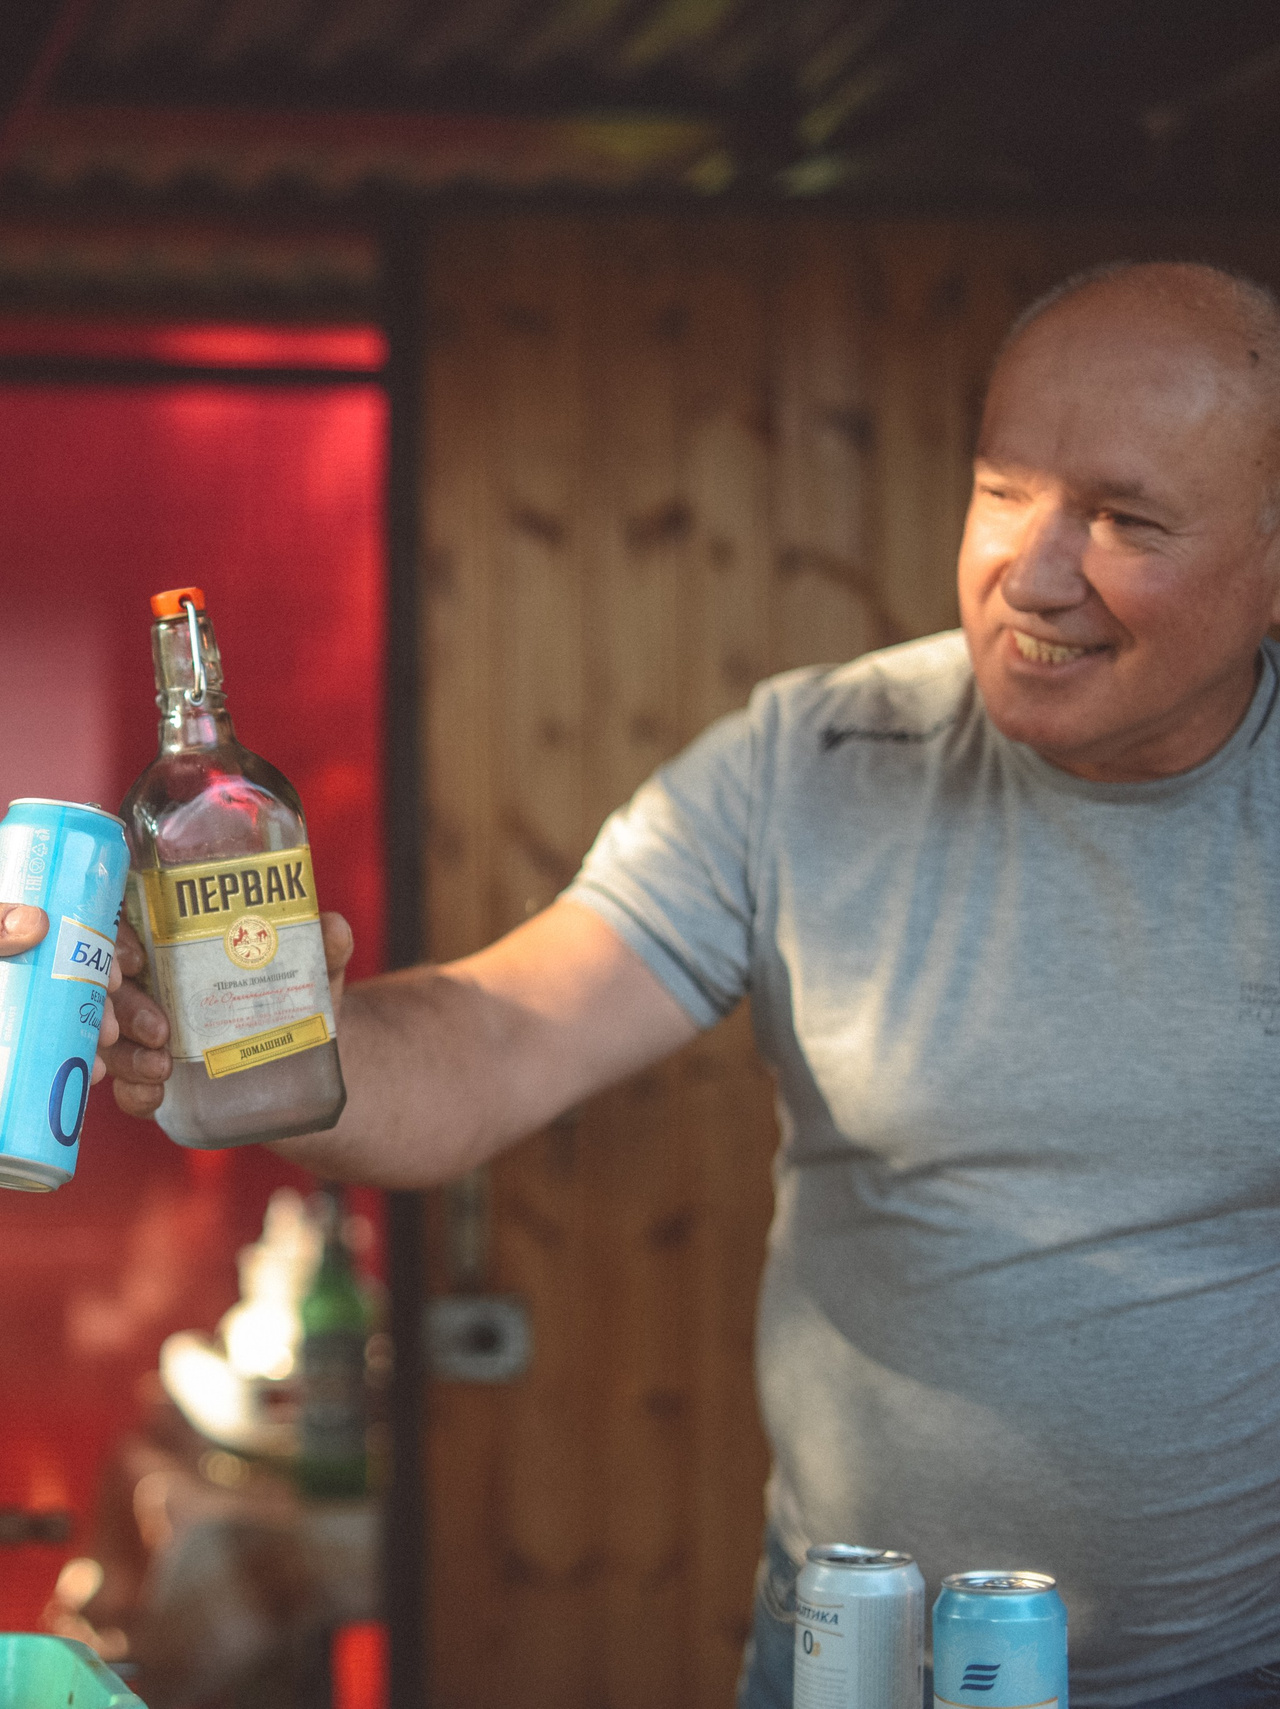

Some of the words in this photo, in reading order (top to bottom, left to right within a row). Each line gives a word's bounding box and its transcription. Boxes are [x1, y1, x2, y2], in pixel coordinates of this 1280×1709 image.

[175, 862, 308, 918] ПЕРВАК
[70, 941, 113, 977] БАЛ
[240, 1032, 294, 1060] ДОМАШНИЙ
[48, 1056, 89, 1147] 0
